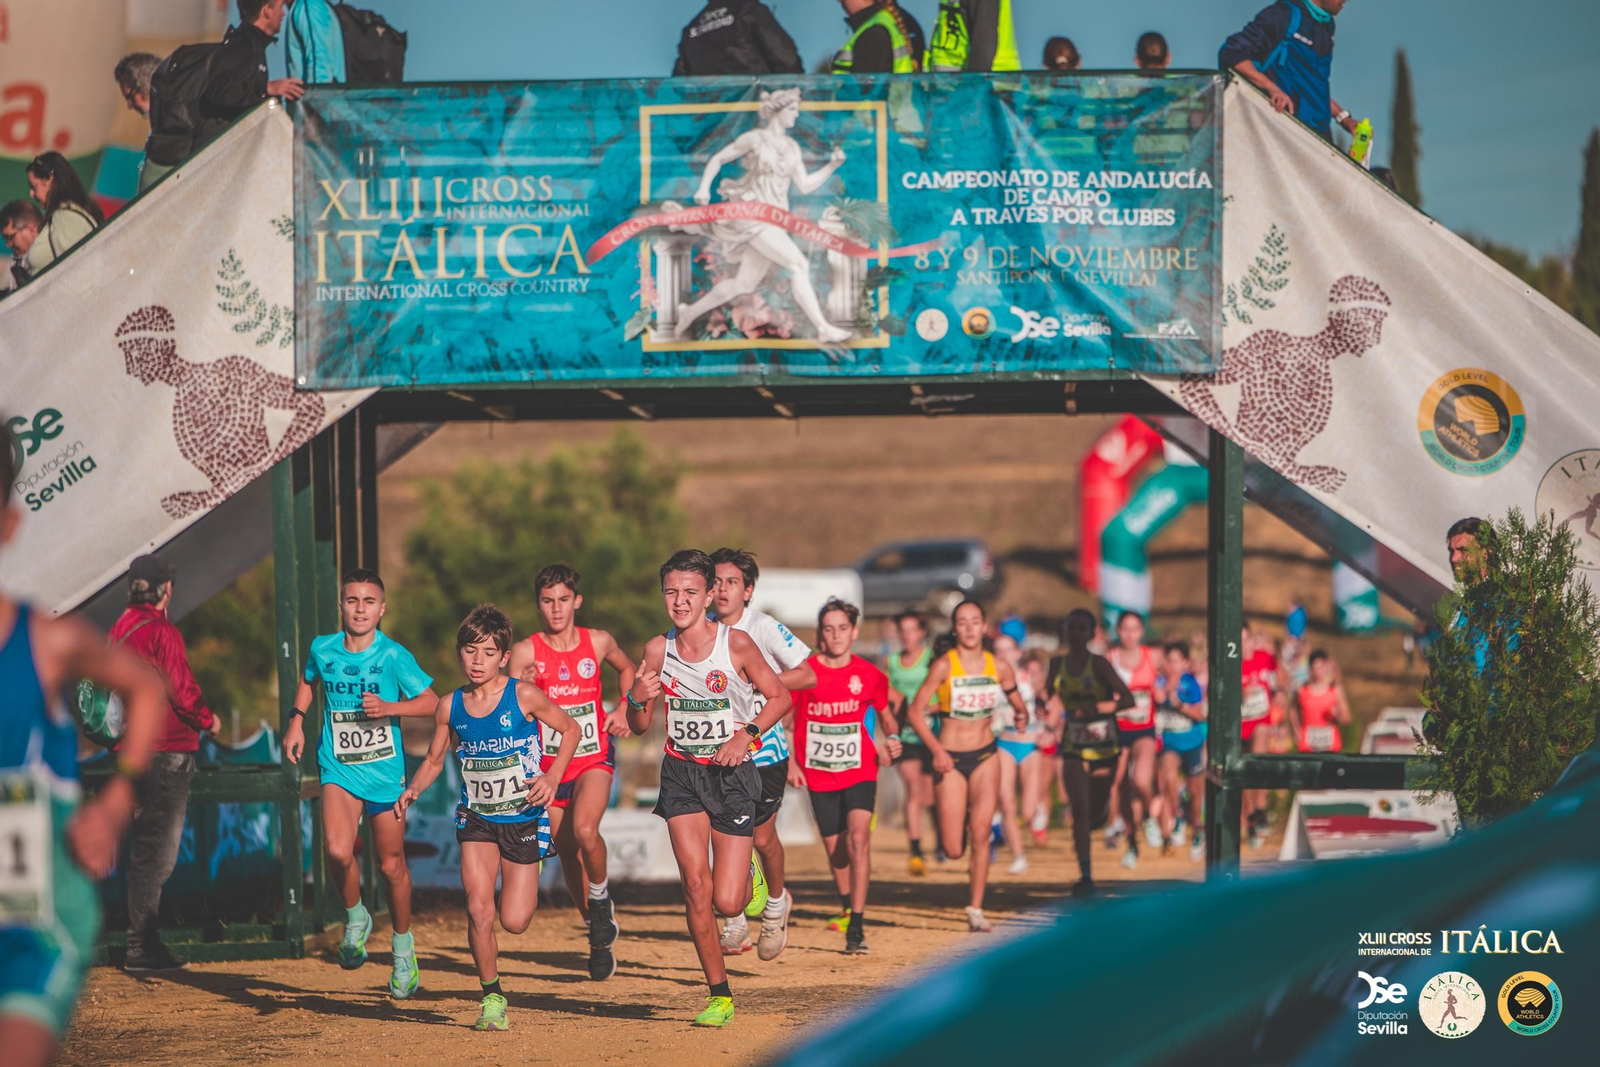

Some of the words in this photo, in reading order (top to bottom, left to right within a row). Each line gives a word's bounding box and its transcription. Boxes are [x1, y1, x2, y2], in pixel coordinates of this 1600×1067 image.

[446, 175, 554, 203] CROSS
[902, 168, 1049, 189] CAMPEONATO
[1052, 170, 1080, 188] DE
[1084, 170, 1213, 189] ANDALUCÍA
[1004, 187, 1029, 206] DE
[1032, 188, 1111, 207] CAMPO
[446, 203, 590, 221] INTERNACIONAL
[950, 208, 968, 226] A
[971, 204, 1049, 225] TRAVÉS
[1052, 207, 1094, 225] POR
[1097, 208, 1176, 226] CLUBES
[610, 216, 658, 245] CROSS
[315, 215, 593, 283] ITÁLICA
[914, 251, 930, 270] 8
[938, 249, 956, 269] Y
[963, 247, 978, 270] 9
[988, 246, 1022, 269] DE
[1029, 245, 1199, 271] NOVIEMBRE
[1074, 269, 1157, 287] (SEVILLA)
[315, 283, 453, 302] INTERNATIONAL
[455, 282, 507, 298] CROSS
[508, 278, 590, 295] COUNTRY
[1063, 321, 1112, 337] Sevilla
[1461, 372, 1489, 384] LEVEL
[1438, 425, 1481, 459] ATHLETICS
[1449, 421, 1479, 447] WORLD
[14, 440, 85, 496] Diputación
[25, 455, 97, 512] Sevilla
[282, 641, 290, 657] 1
[1227, 641, 1239, 659] 2
[324, 677, 381, 699] nerja
[339, 726, 388, 749] 8023
[674, 719, 730, 740] 5821
[812, 741, 857, 758] 7950
[470, 775, 524, 799] 7971
[520, 834, 537, 842] vive
